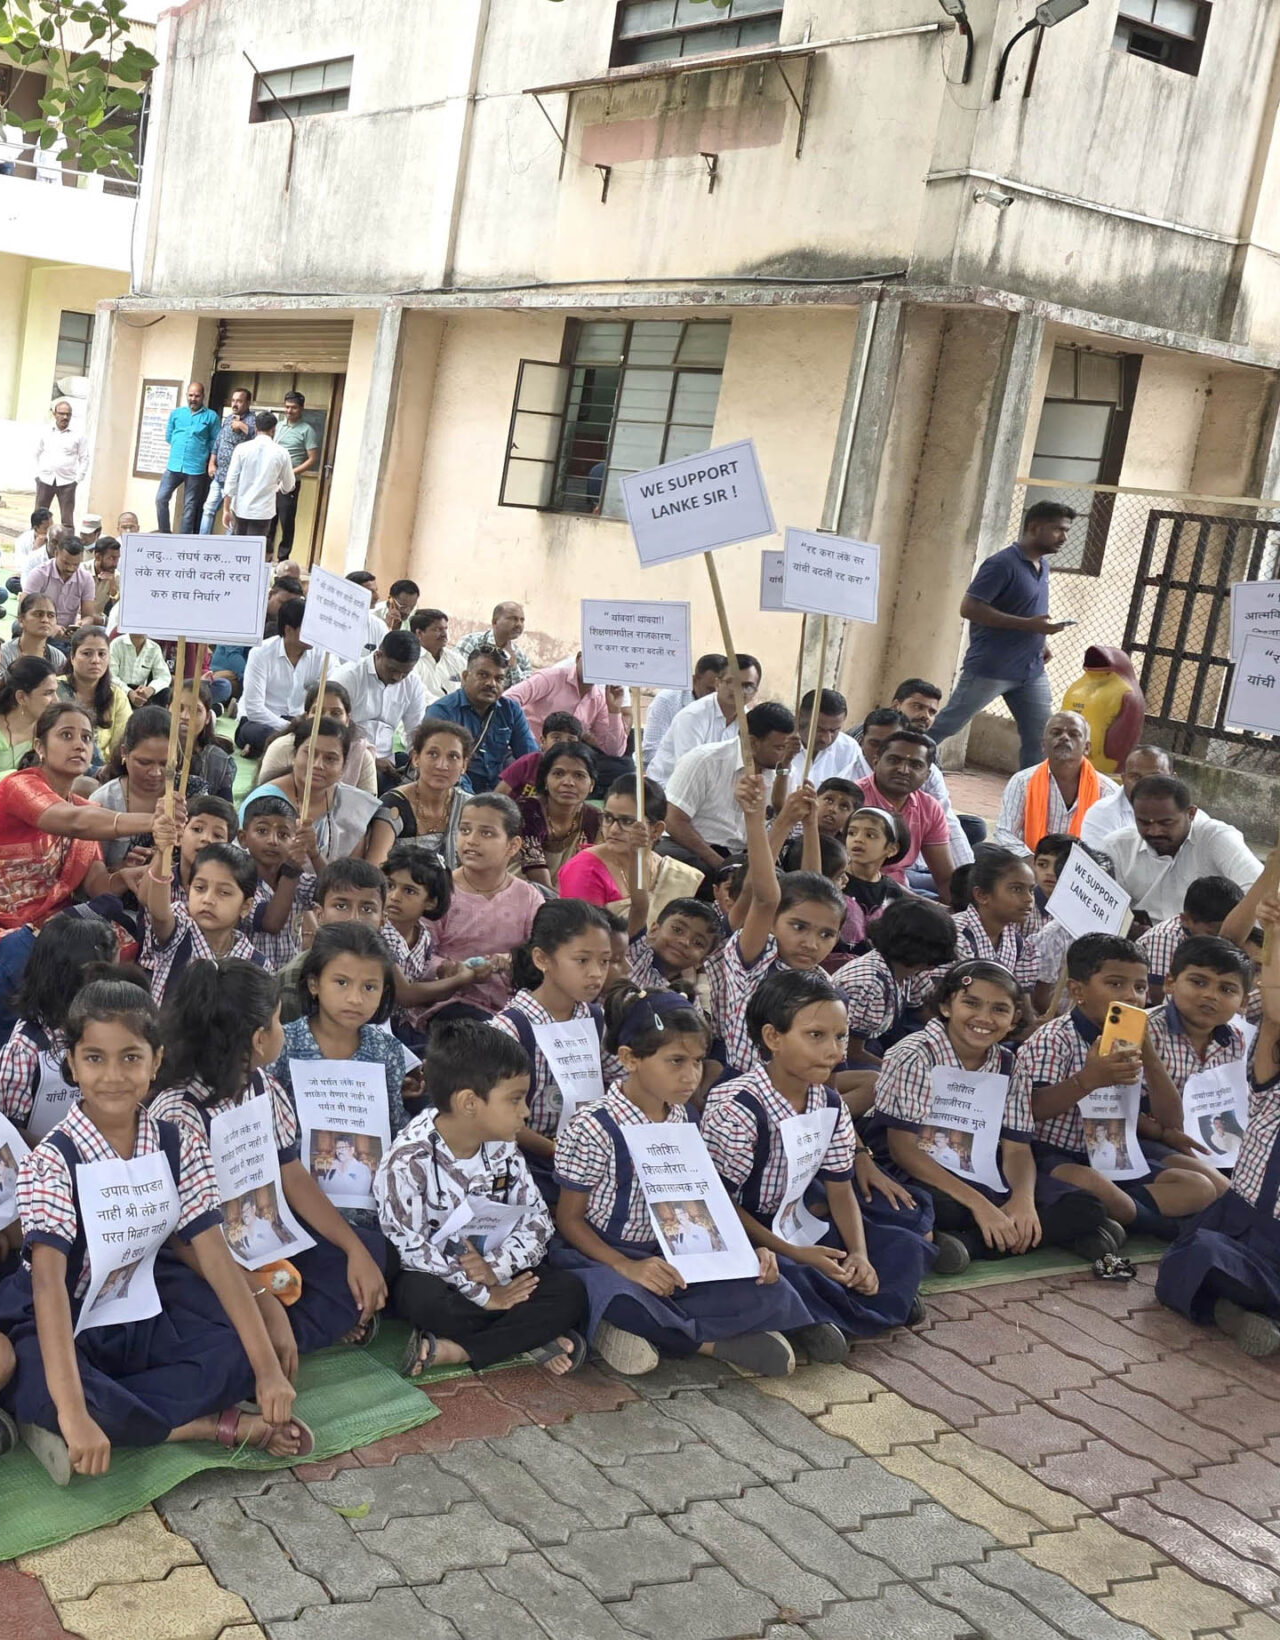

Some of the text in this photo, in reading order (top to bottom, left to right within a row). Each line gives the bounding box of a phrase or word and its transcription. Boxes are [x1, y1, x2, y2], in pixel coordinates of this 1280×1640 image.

[640, 461, 738, 498] WE SUPPORT
[652, 496, 700, 519] LANKE
[704, 489, 728, 505] SIR
[235, 556, 251, 564] पण
[820, 549, 834, 559] करा
[854, 556, 865, 565] सर
[135, 566, 224, 581] लंके सर यांची बदली
[812, 566, 833, 579] बदली
[172, 591, 190, 600] हाच
[1248, 674, 1275, 688] यांची
[1074, 862, 1119, 909] WE SUPPORT
[1070, 881, 1093, 908] LANKE
[1092, 904, 1104, 920] SIR
[46, 1089, 67, 1103] यांची
[350, 1092, 365, 1100] नाही
[350, 1118, 365, 1128] नाही
[972, 1119, 986, 1130] मुले
[248, 1136, 262, 1148] नाही
[250, 1168, 264, 1181] नाही
[642, 1162, 687, 1175] शिवाजीराव
[100, 1185, 129, 1198] उपाय
[96, 1205, 121, 1221] नाही
[125, 1203, 137, 1218] श्री
[140, 1202, 158, 1217] लंके
[101, 1231, 125, 1244] परत
[127, 1226, 150, 1241] मिळत
